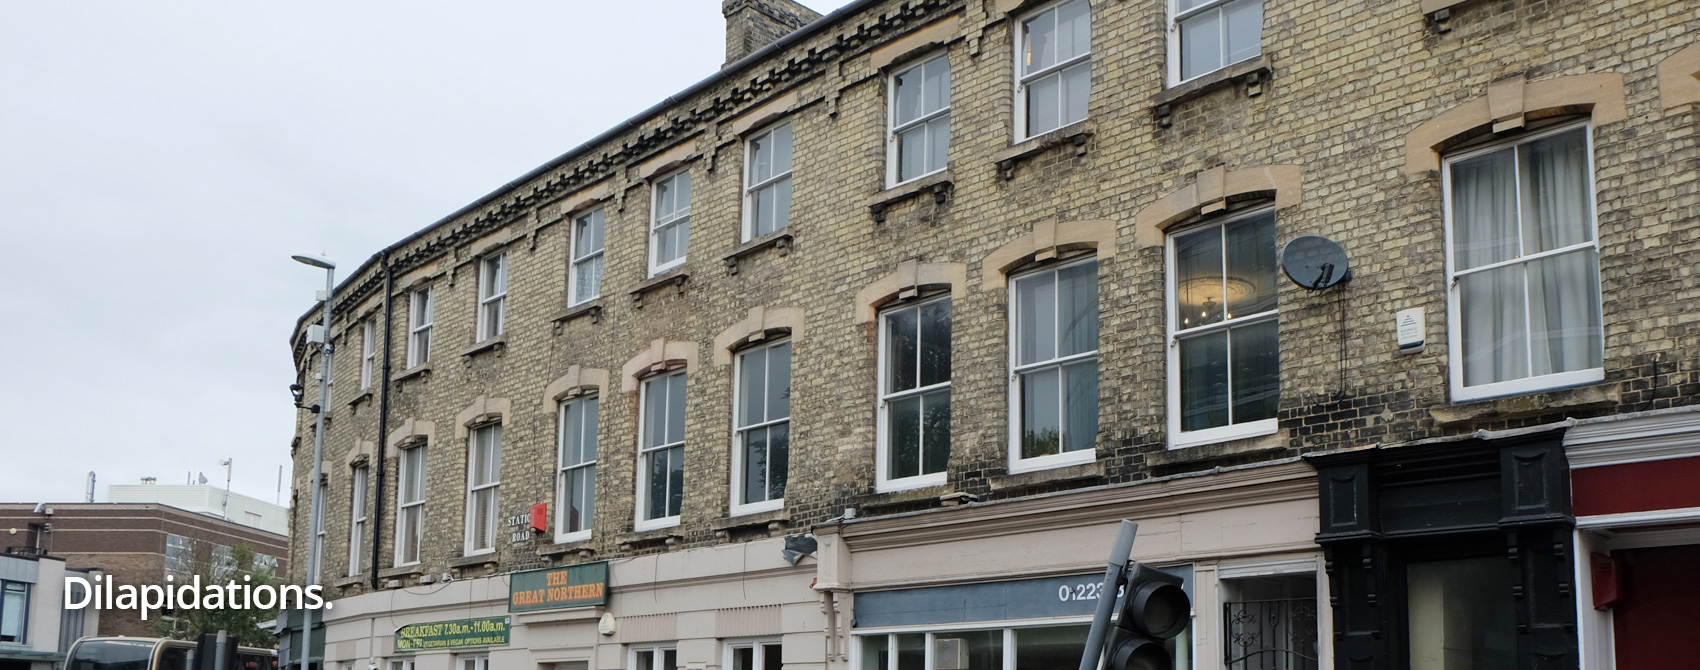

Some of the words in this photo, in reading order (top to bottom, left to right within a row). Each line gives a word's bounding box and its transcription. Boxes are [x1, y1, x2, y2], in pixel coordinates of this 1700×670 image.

[508, 513, 530, 526] STATIO
[512, 530, 530, 543] ROAD
[546, 571, 568, 586] THE
[512, 589, 545, 606] GREAT
[547, 582, 604, 602] NORTHERN
[400, 624, 443, 638] BREAKFAST
[450, 638, 464, 646] VEGAN
[464, 637, 482, 645] OPTIONS
[482, 636, 505, 644] AVAILABLE
